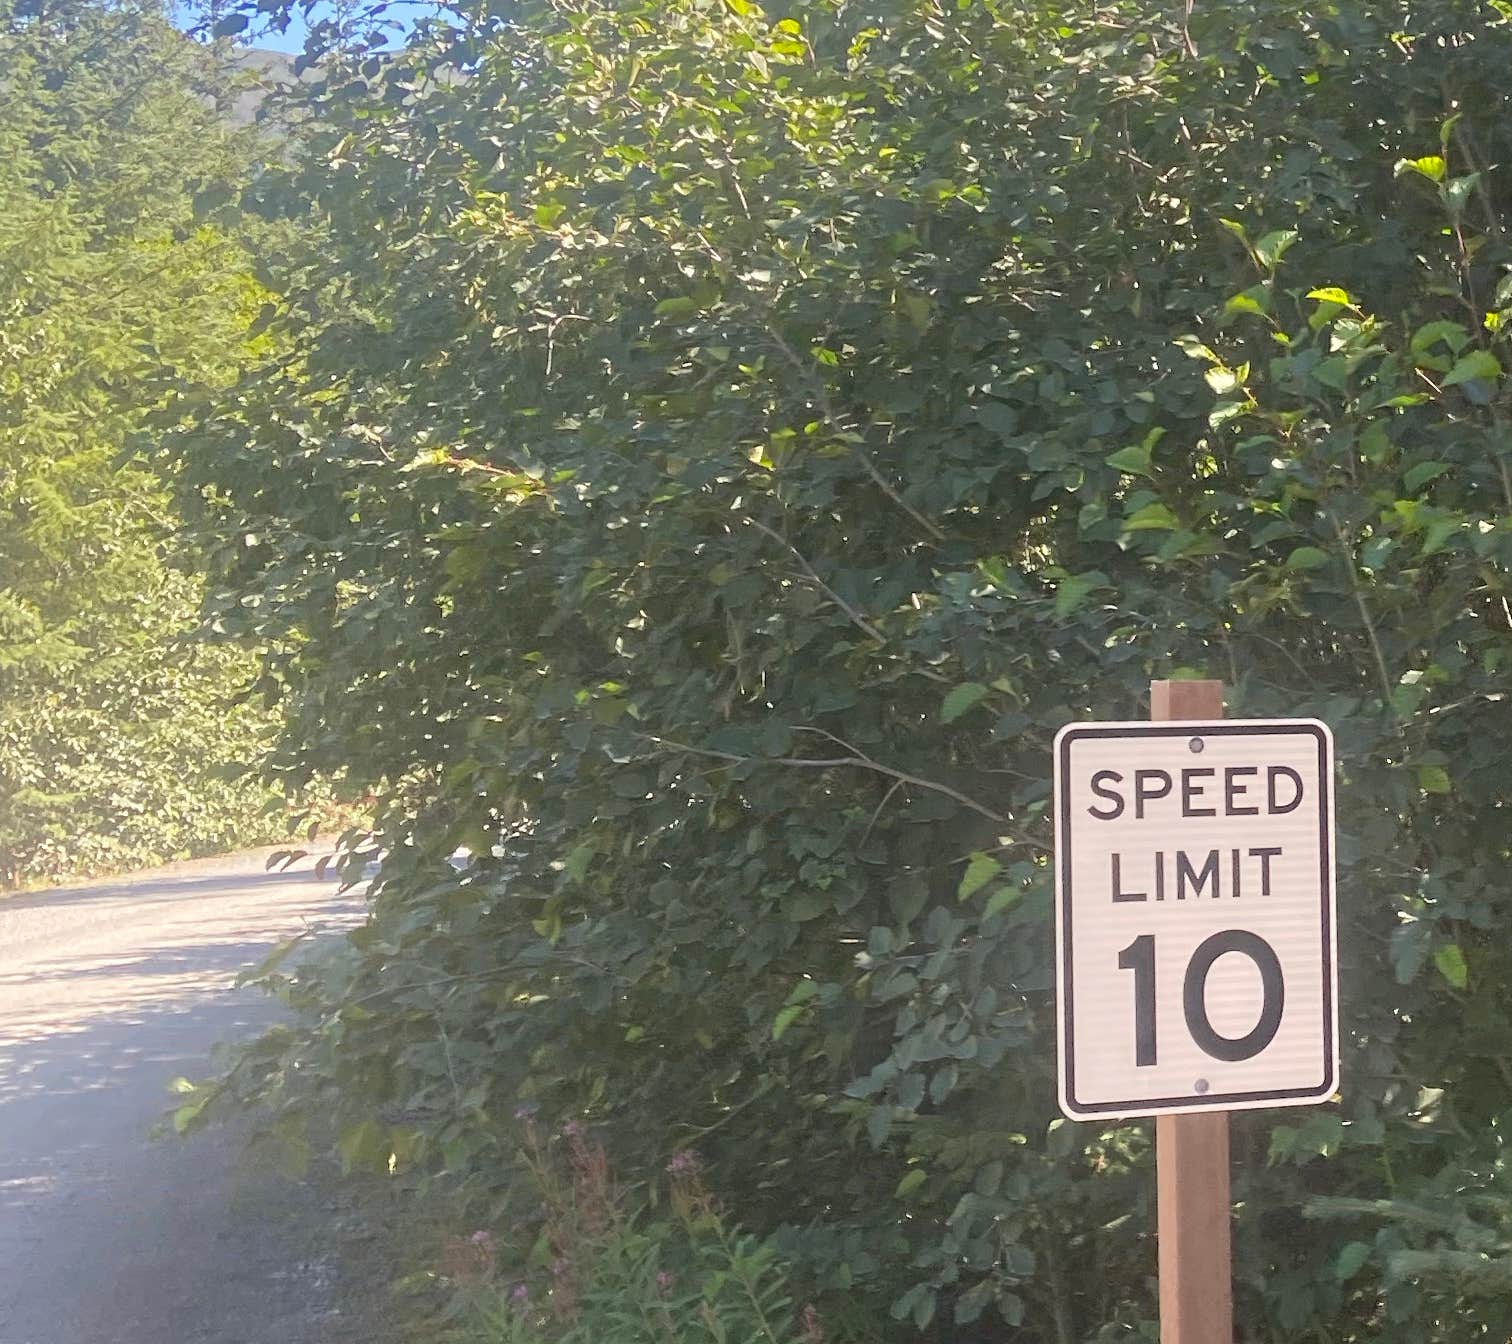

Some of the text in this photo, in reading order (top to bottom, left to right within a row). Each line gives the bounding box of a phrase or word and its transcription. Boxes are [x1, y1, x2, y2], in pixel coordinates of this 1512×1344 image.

[1087, 766, 1304, 820] SPEED
[1111, 847, 1283, 903] LIMIT
[1118, 929, 1285, 1067] 10
